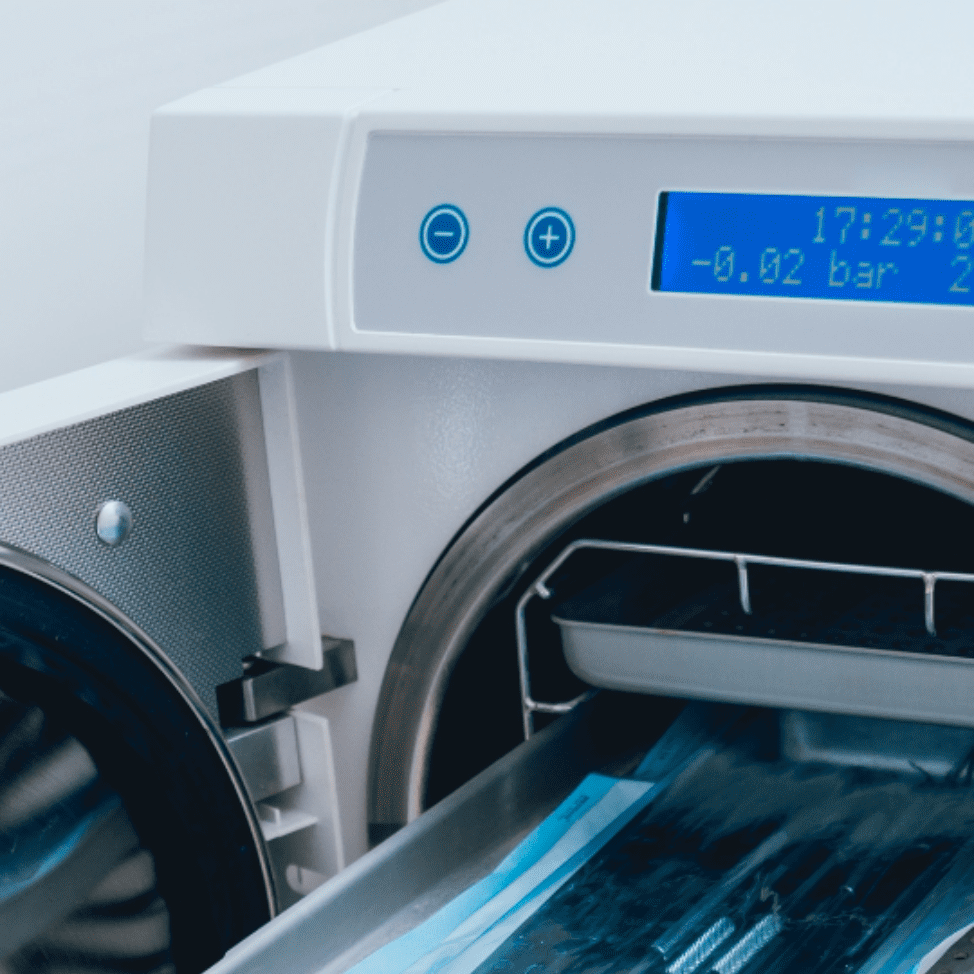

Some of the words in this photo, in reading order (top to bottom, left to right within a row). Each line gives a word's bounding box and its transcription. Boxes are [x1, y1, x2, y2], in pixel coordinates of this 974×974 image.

[812, 206, 974, 249] 17:29:0
[691, 245, 805, 285] -0.02
[828, 249, 899, 289] bar
